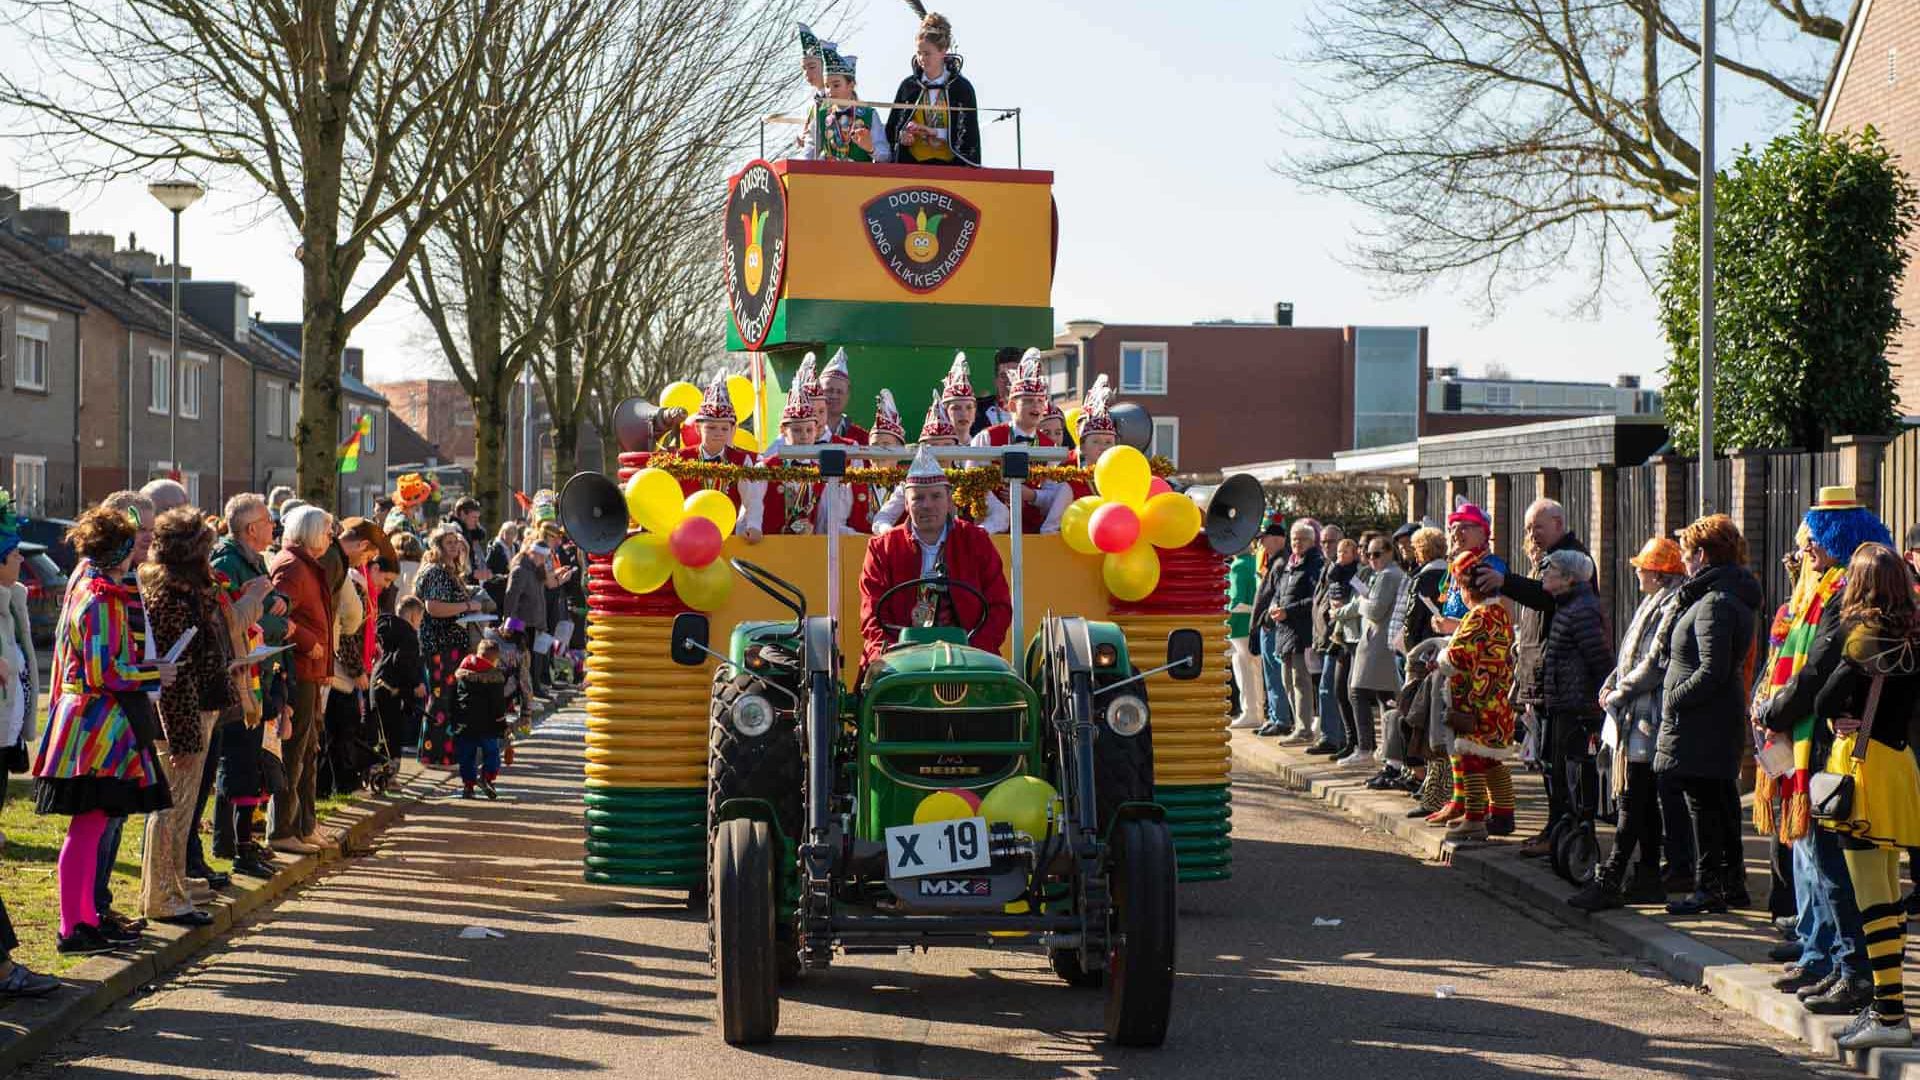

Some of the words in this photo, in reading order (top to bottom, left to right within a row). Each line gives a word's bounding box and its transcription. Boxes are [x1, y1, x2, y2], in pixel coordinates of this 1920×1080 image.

[740, 167, 770, 199] DOOSPEL
[888, 190, 954, 212] DOOSPEL
[867, 217, 892, 256] JONG
[889, 219, 976, 288] VLIKKESTAEKERS
[725, 239, 737, 293] JONG
[734, 239, 784, 343] VLIKKESTAEKERS
[895, 833, 924, 868] X
[943, 821, 979, 864] 19
[920, 879, 969, 894] MX
